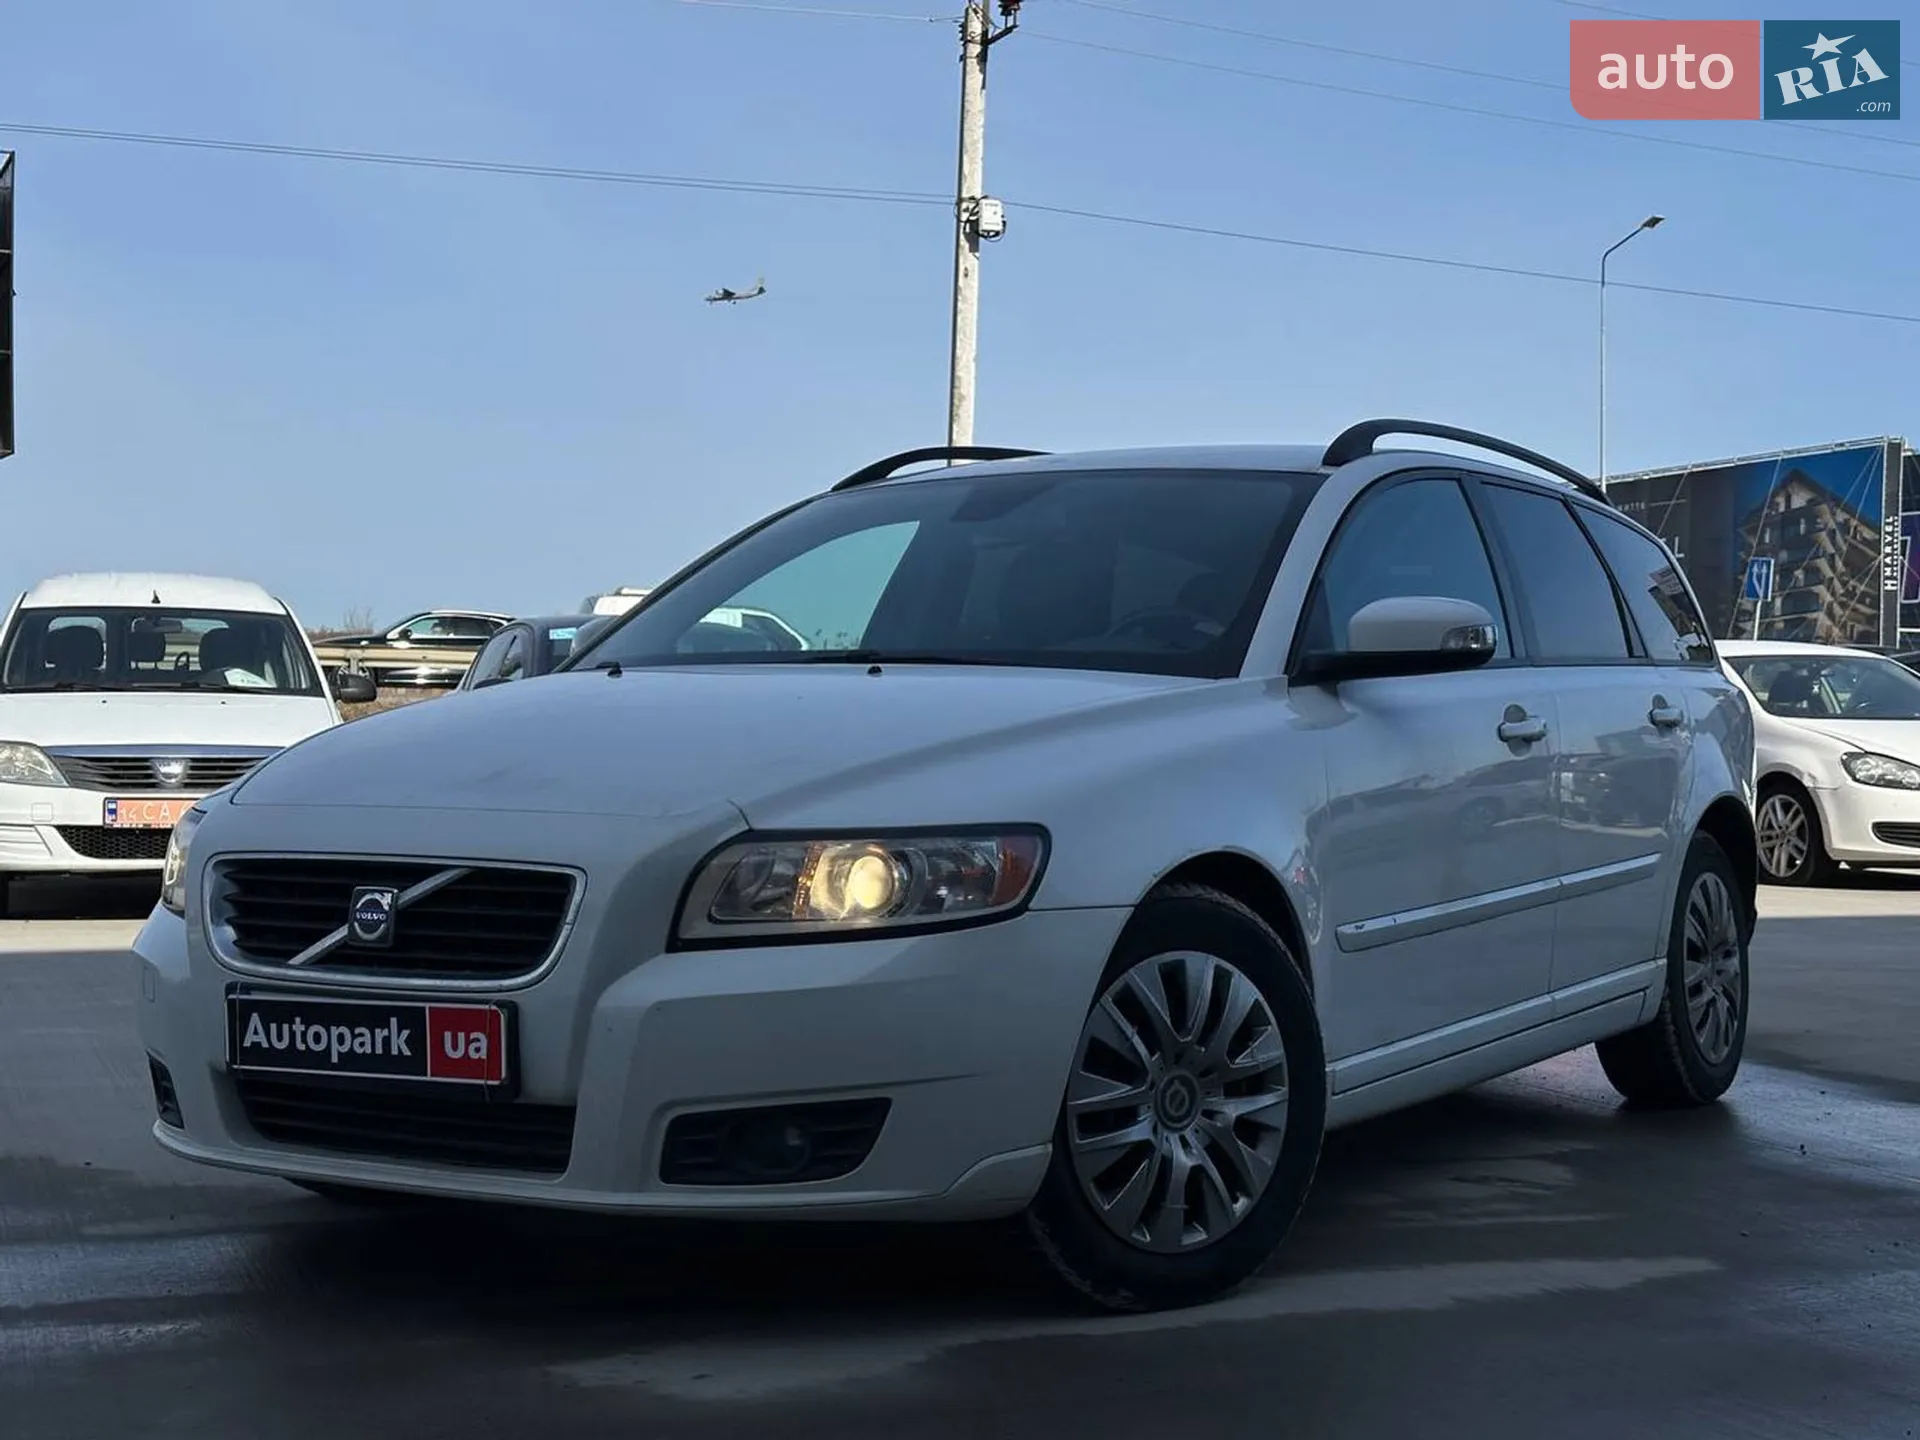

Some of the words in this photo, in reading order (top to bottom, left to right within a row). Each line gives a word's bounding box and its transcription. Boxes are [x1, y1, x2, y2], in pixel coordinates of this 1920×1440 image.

[355, 912, 387, 921] VOLVO
[243, 1012, 412, 1064] Autopark
[444, 1031, 489, 1060] ua
